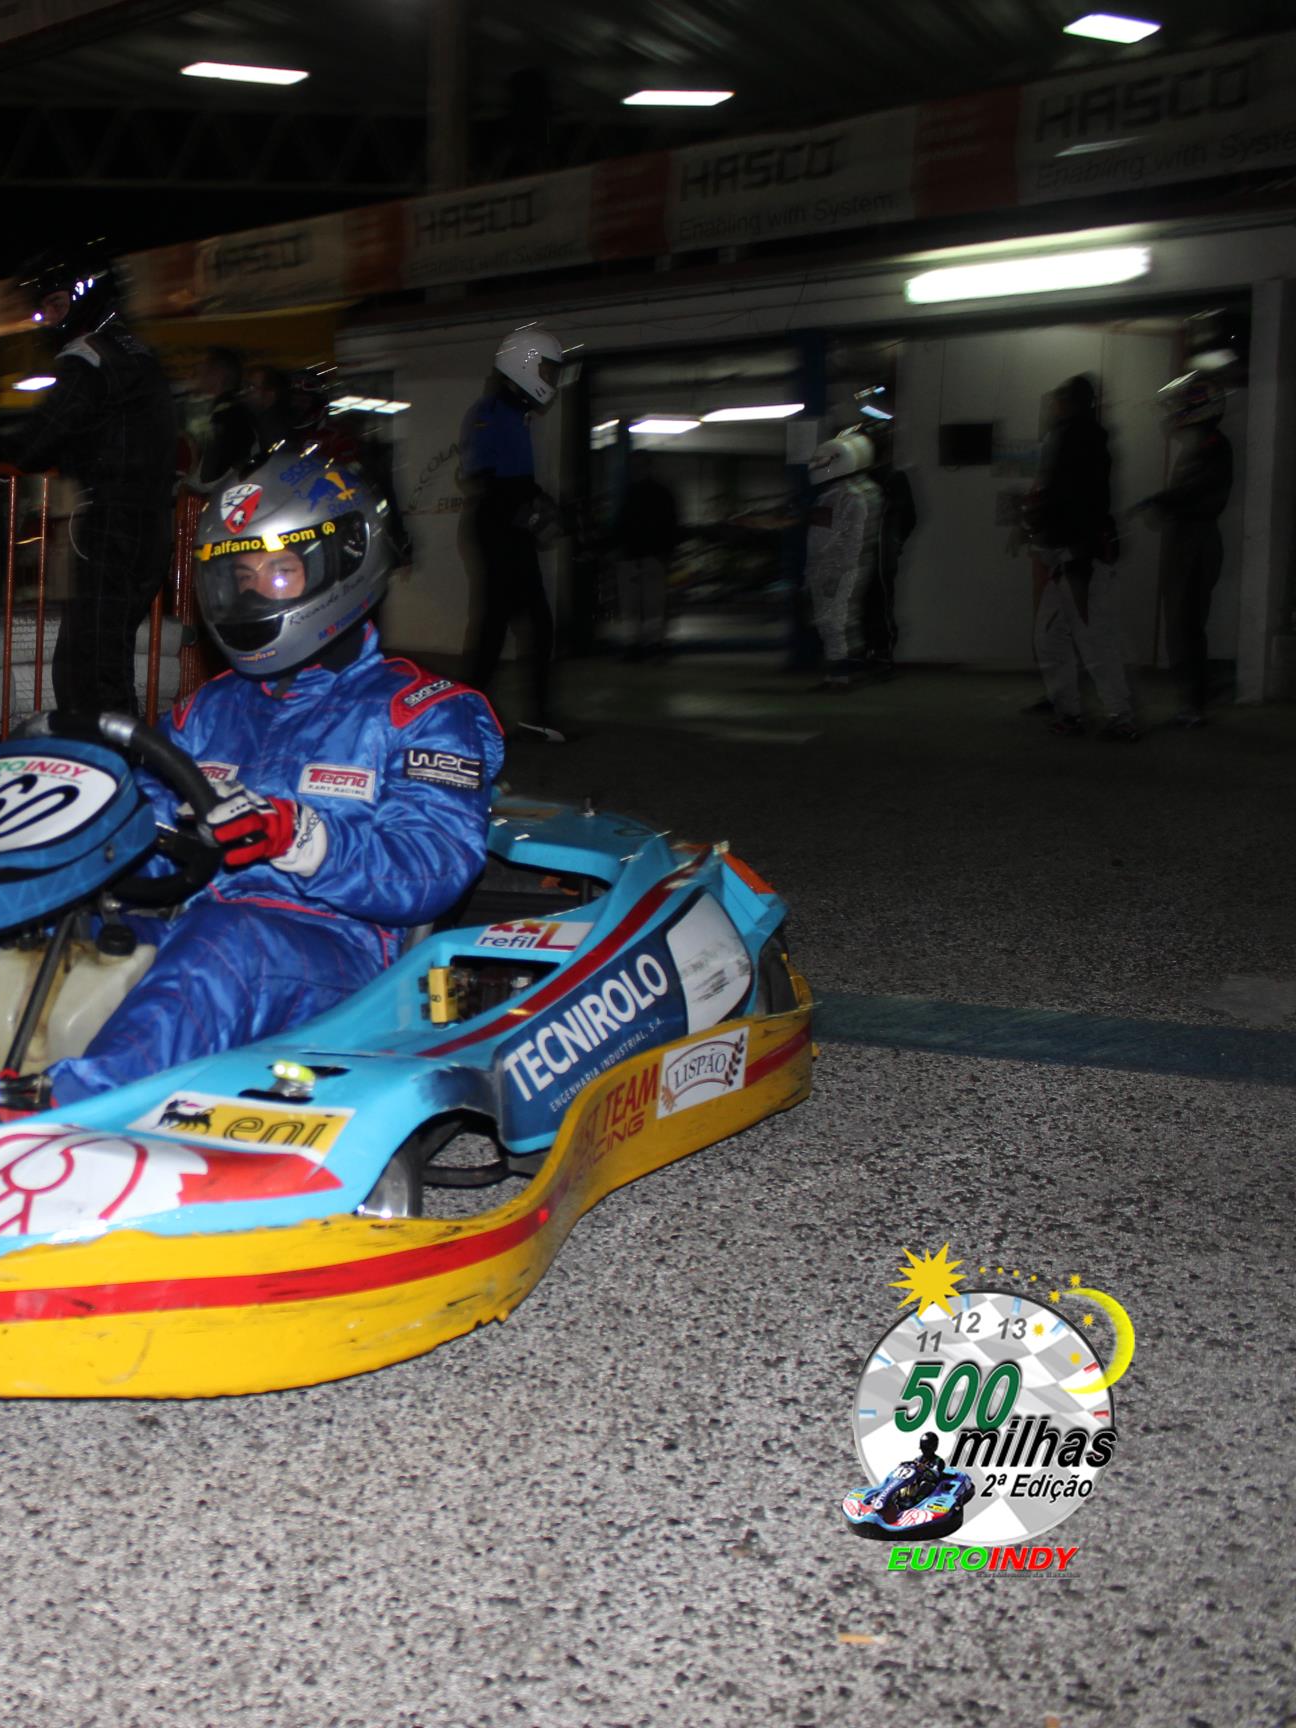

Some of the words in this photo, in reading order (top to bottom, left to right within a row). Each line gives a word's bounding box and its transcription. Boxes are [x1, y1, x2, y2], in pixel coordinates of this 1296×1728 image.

[1036, 59, 1255, 143] HASCO
[680, 135, 843, 201] HASCO
[413, 189, 536, 248] HASCO
[679, 213, 761, 242] Enabling
[767, 205, 805, 228] with
[408, 749, 481, 777] WRC
[504, 953, 668, 1102] TECNIROLO
[604, 1063, 659, 1133] TEAM
[223, 1113, 337, 1148] eni
